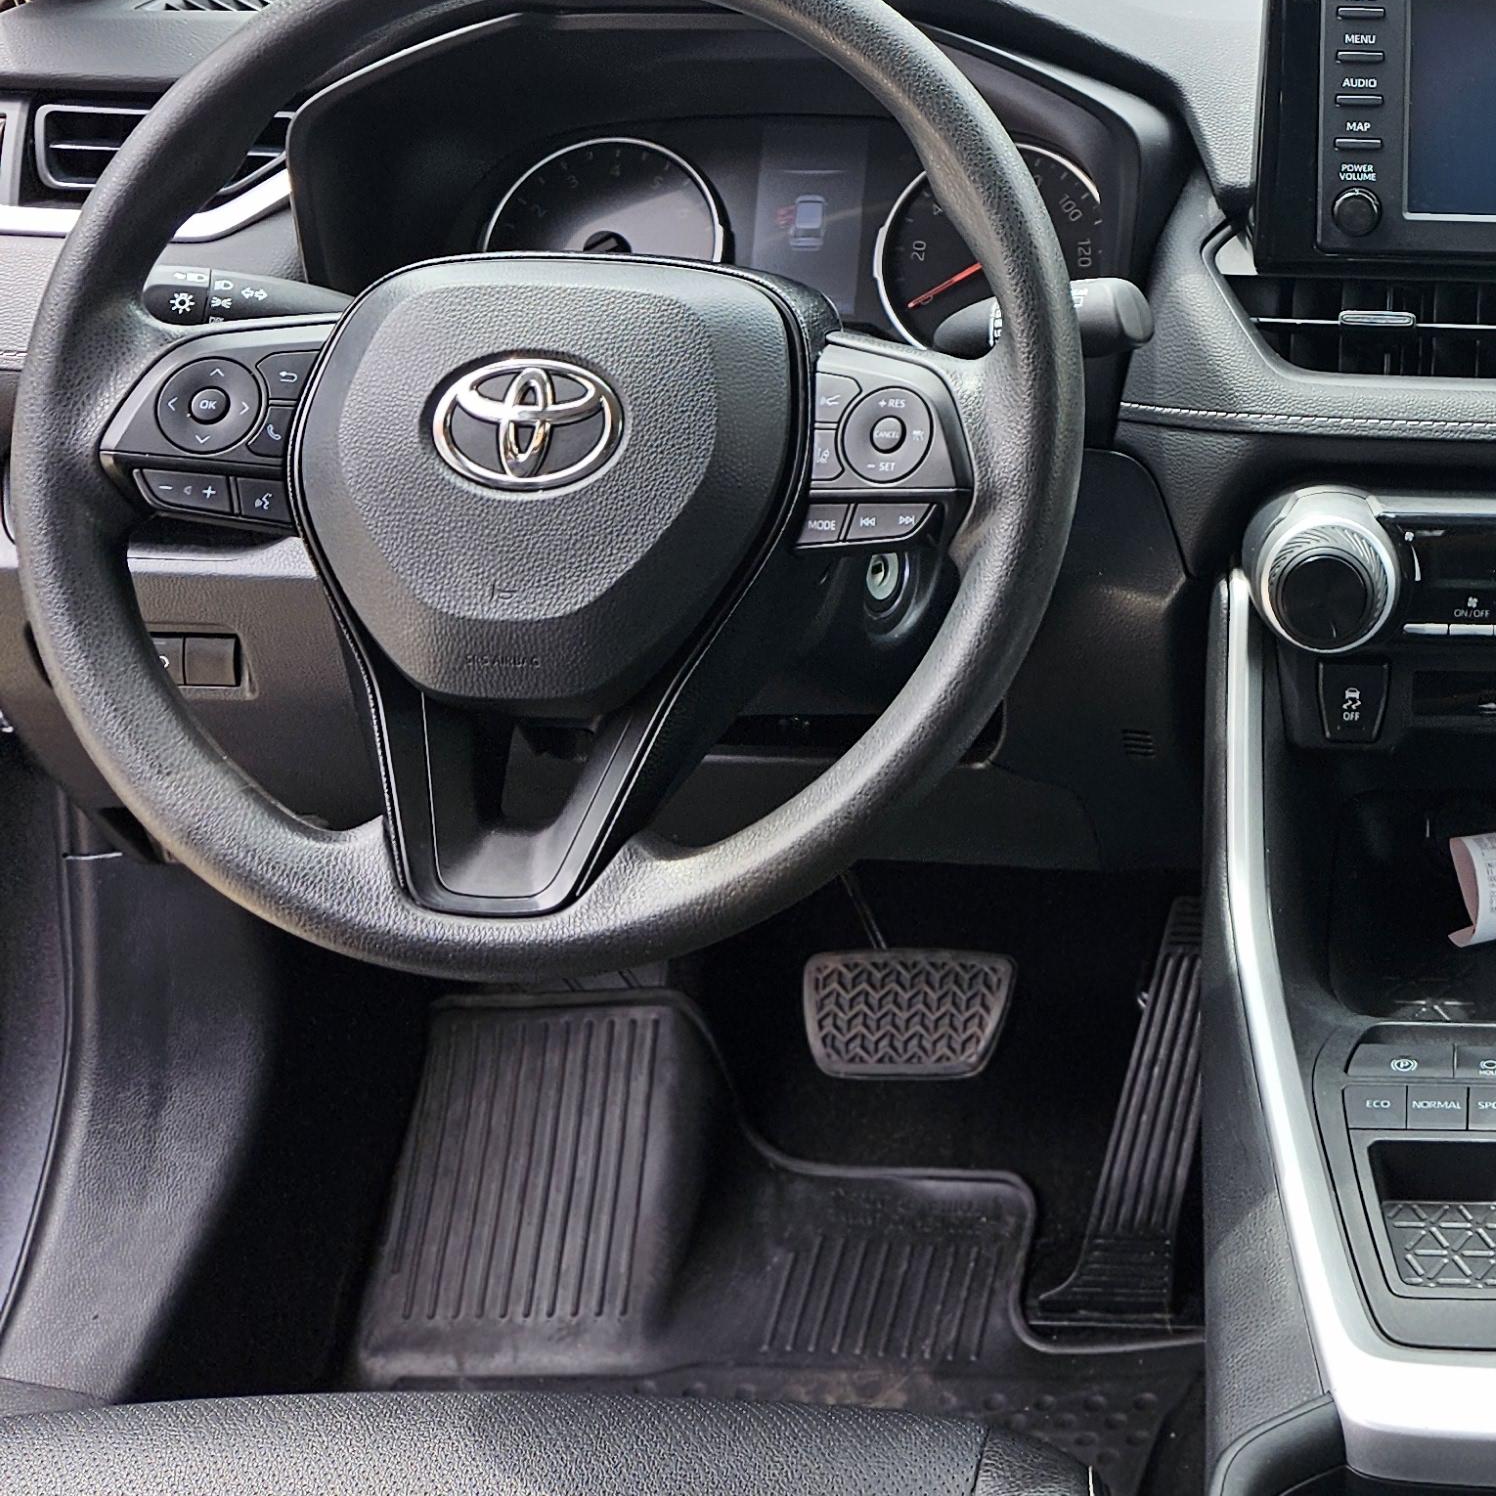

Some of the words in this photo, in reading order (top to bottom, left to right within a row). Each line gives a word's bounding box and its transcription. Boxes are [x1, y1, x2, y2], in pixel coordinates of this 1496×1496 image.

[1344, 34, 1376, 44] MENU
[1342, 77, 1378, 88] AUDIO
[1346, 121, 1371, 132] MAP
[1341, 163, 1374, 173] POWER
[1339, 172, 1377, 182] VOLUME
[1057, 192, 1083, 223] 100
[911, 239, 927, 262] 20
[1076, 237, 1092, 268] 120
[199, 400, 217, 410] OK
[873, 428, 900, 439] CANCEL
[808, 519, 836, 531] MODE
[1453, 608, 1490, 619] ON/OFF
[1342, 711, 1361, 721] OFF
[1365, 1099, 1391, 1109] ECO
[1412, 1099, 1462, 1110] NORMAL
